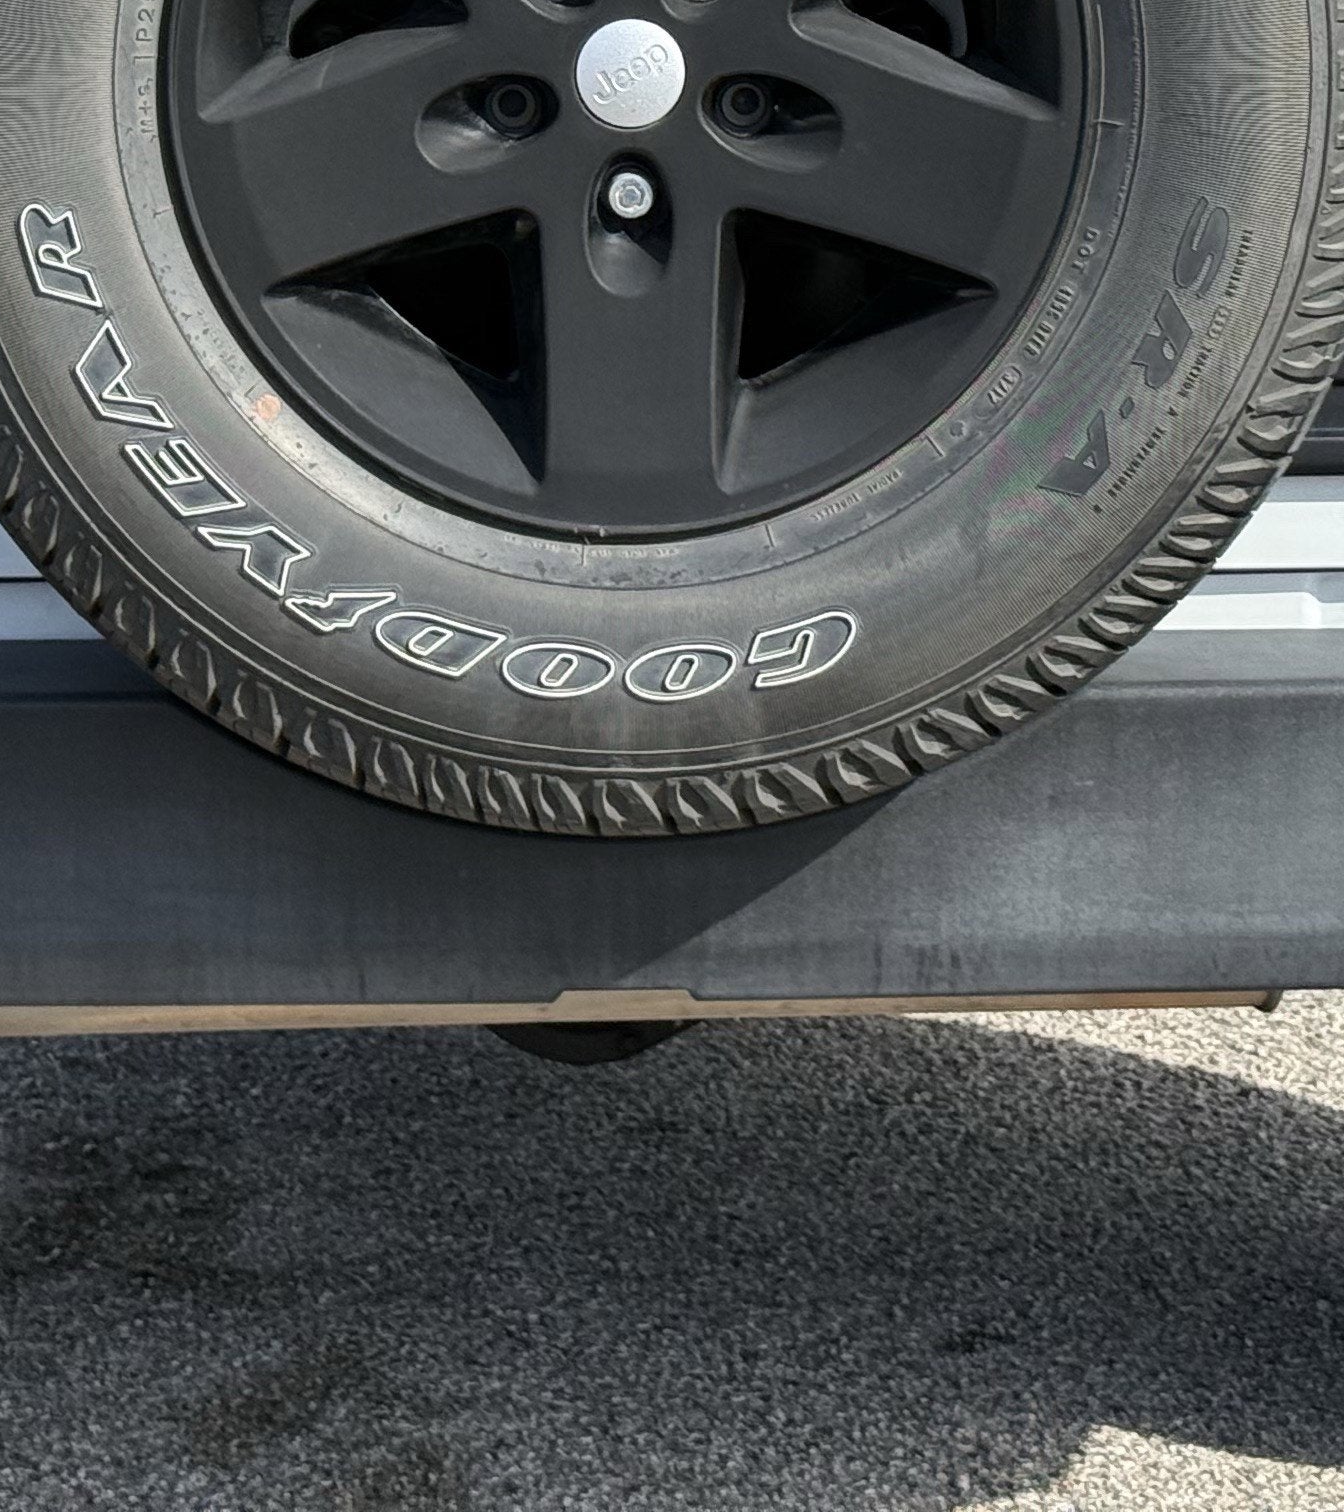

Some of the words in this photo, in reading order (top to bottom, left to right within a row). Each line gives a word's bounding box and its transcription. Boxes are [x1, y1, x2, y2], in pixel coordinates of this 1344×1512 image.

[593, 44, 668, 104] Jeep
[1067, 224, 1102, 276] DOT
[19, 203, 857, 701] GOODYEAR
